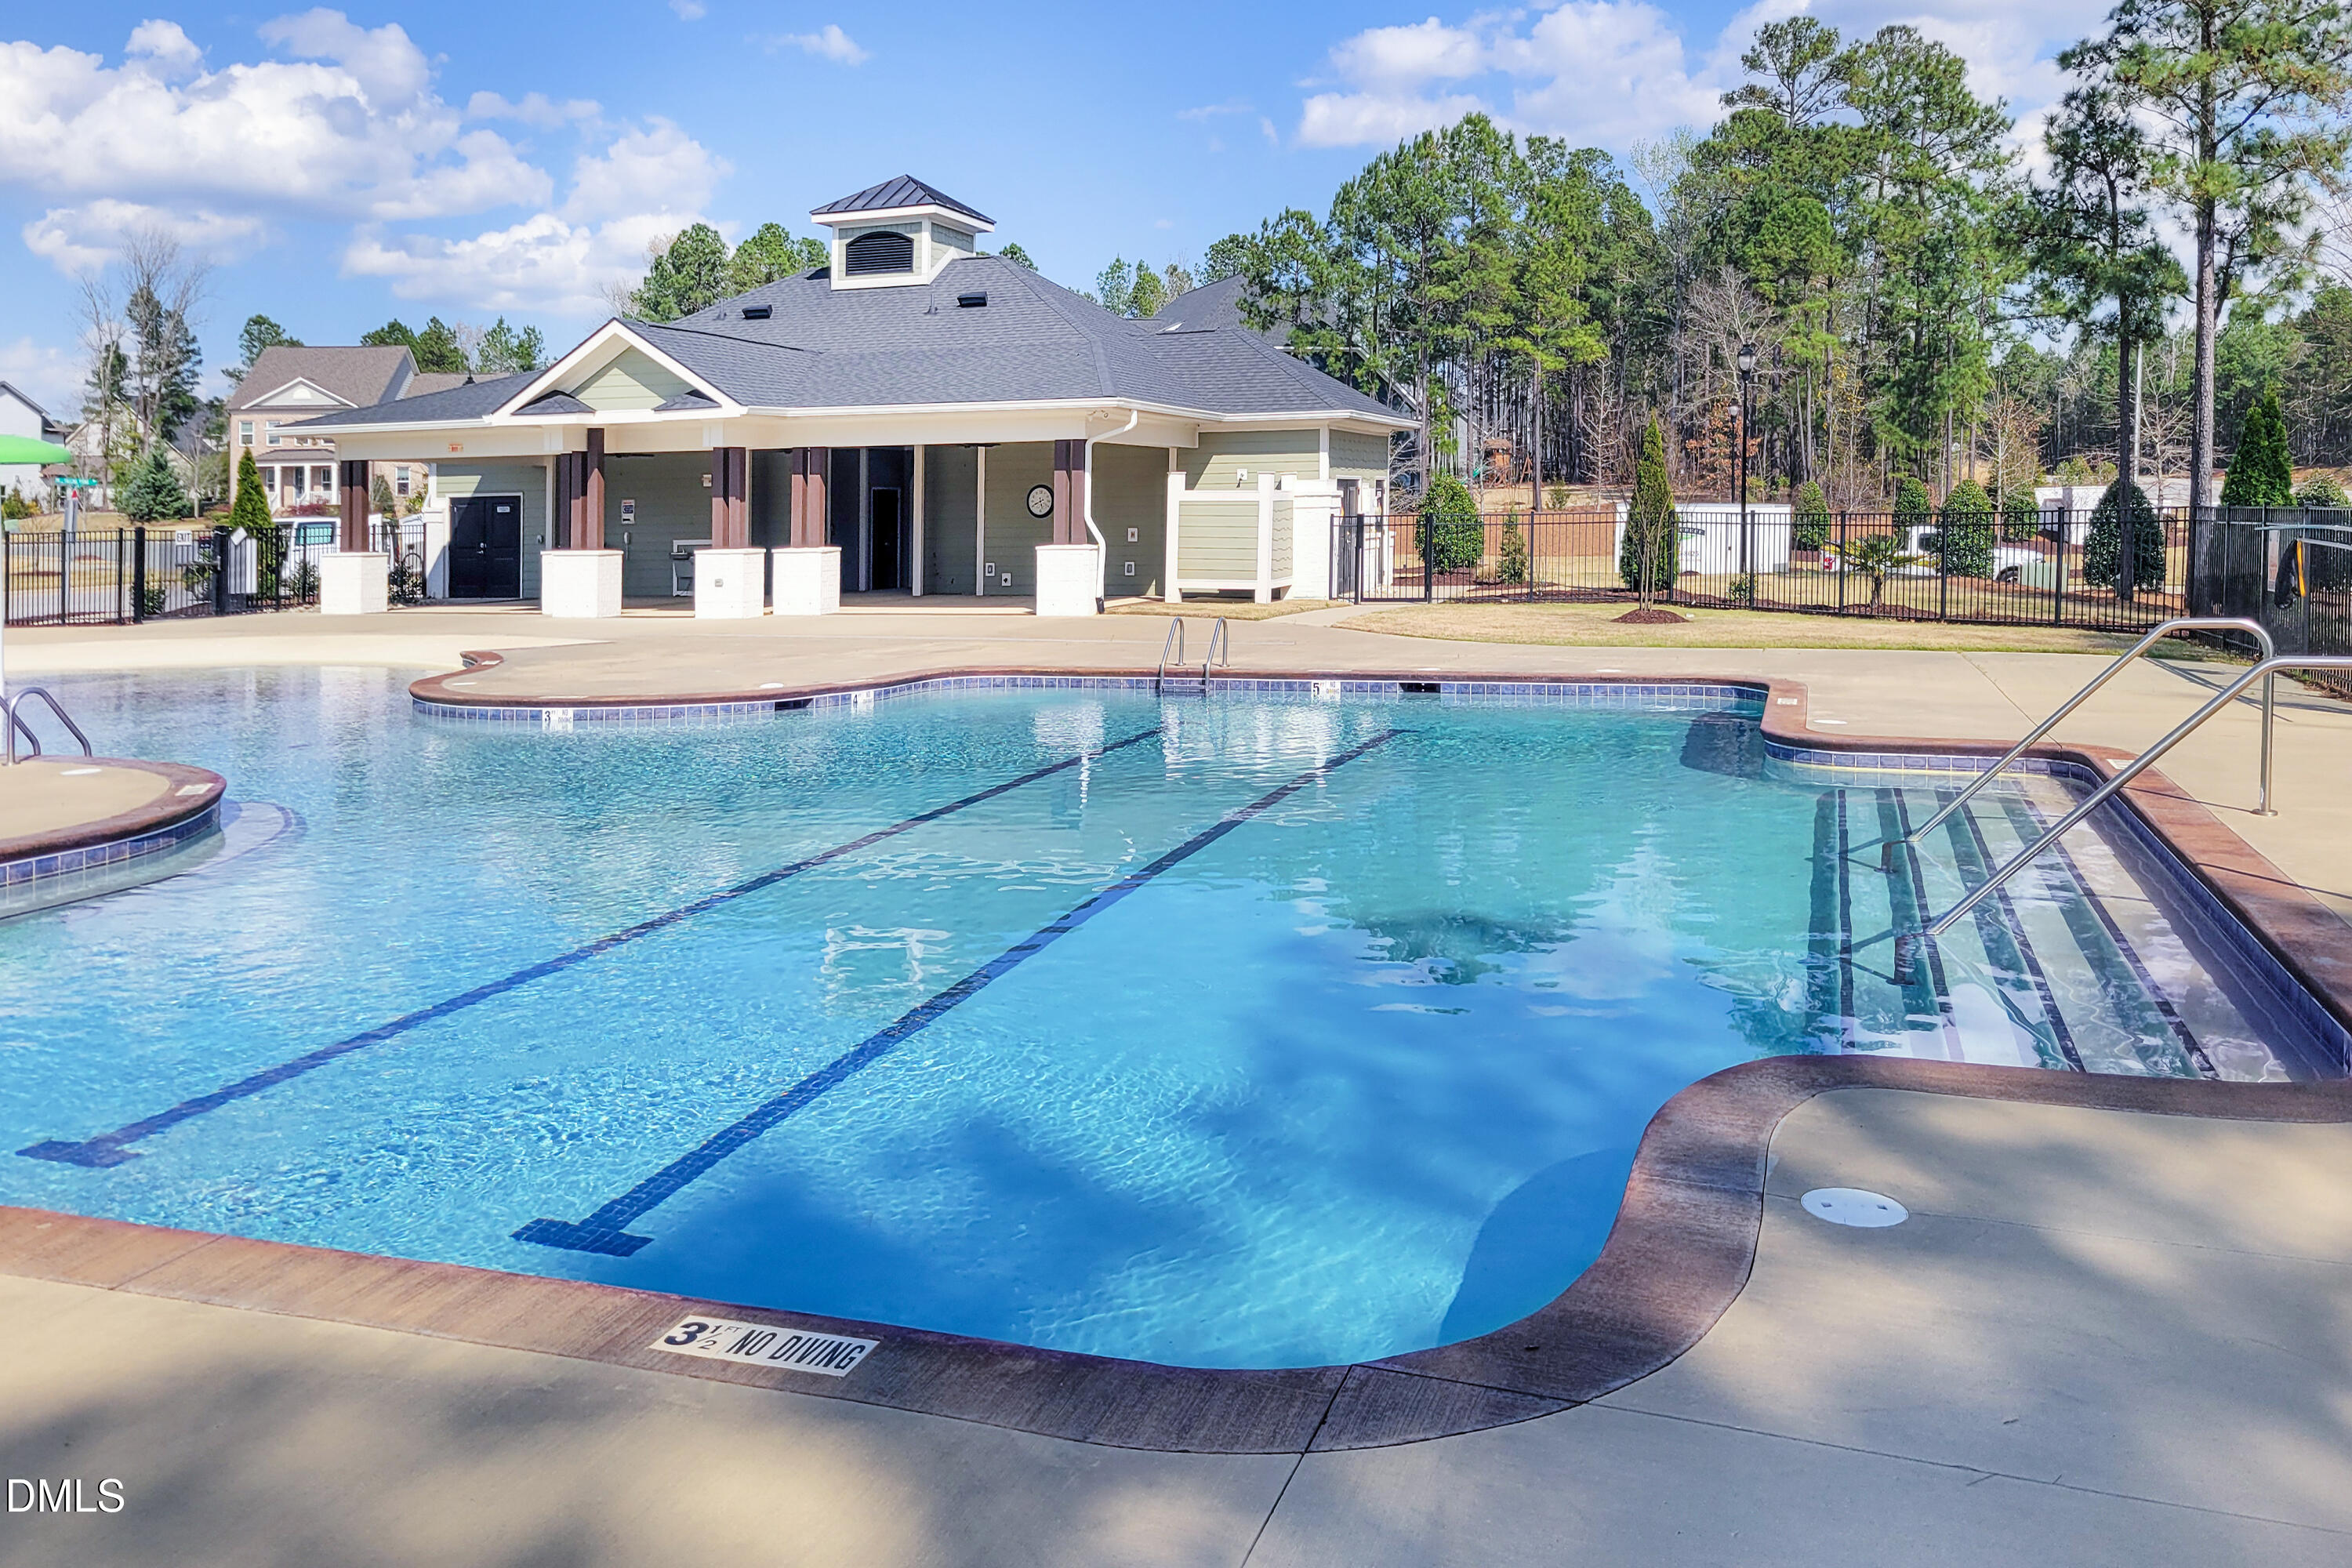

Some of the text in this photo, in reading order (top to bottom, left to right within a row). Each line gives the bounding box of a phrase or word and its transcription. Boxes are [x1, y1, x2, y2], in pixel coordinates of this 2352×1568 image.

[1313, 682, 1320, 696] 5
[544, 710, 551, 722] 3
[725, 1329, 778, 1356] NO
[767, 1334, 866, 1370] DIVING
